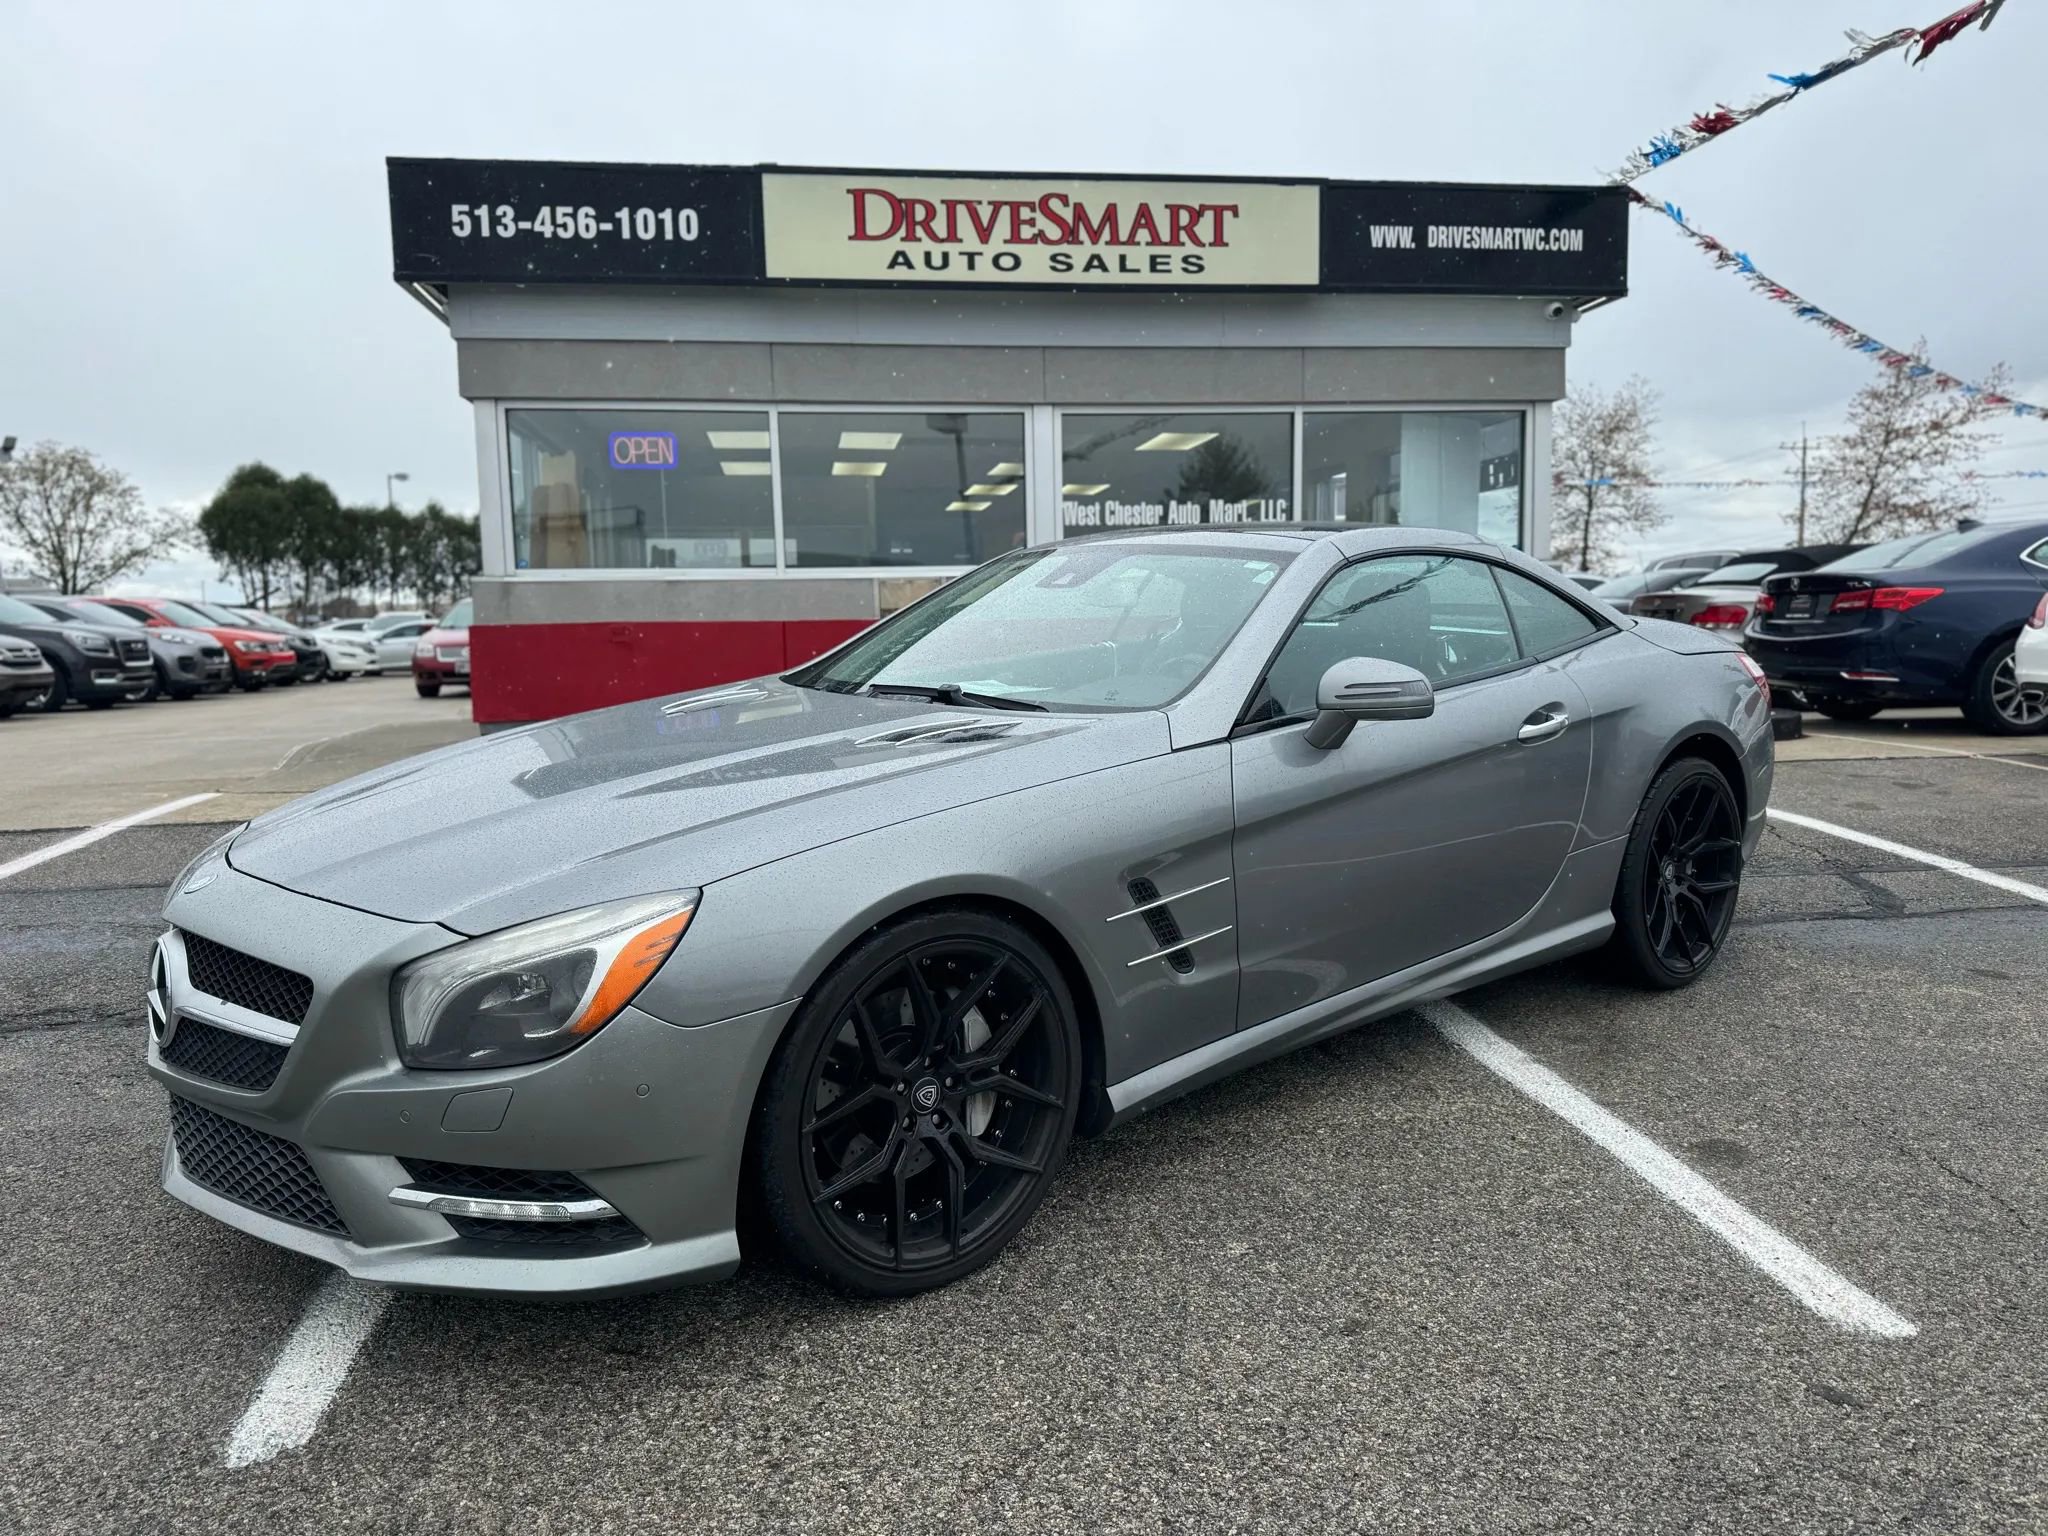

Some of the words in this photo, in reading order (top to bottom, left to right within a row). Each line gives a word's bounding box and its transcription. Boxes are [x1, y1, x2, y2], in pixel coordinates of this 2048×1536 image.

[451, 204, 699, 241] 513-456-1010
[1370, 225, 1416, 249] WWW.
[1427, 225, 1583, 251] DRIVESMARTWC.COM
[887, 250, 1022, 272] AUTO
[1049, 253, 1206, 274] SALES
[614, 436, 674, 464] OPEN
[1063, 501, 1101, 526] West
[1105, 501, 1163, 526] Chester
[1168, 500, 1201, 525] Auto
[1260, 499, 1287, 522] LLC
